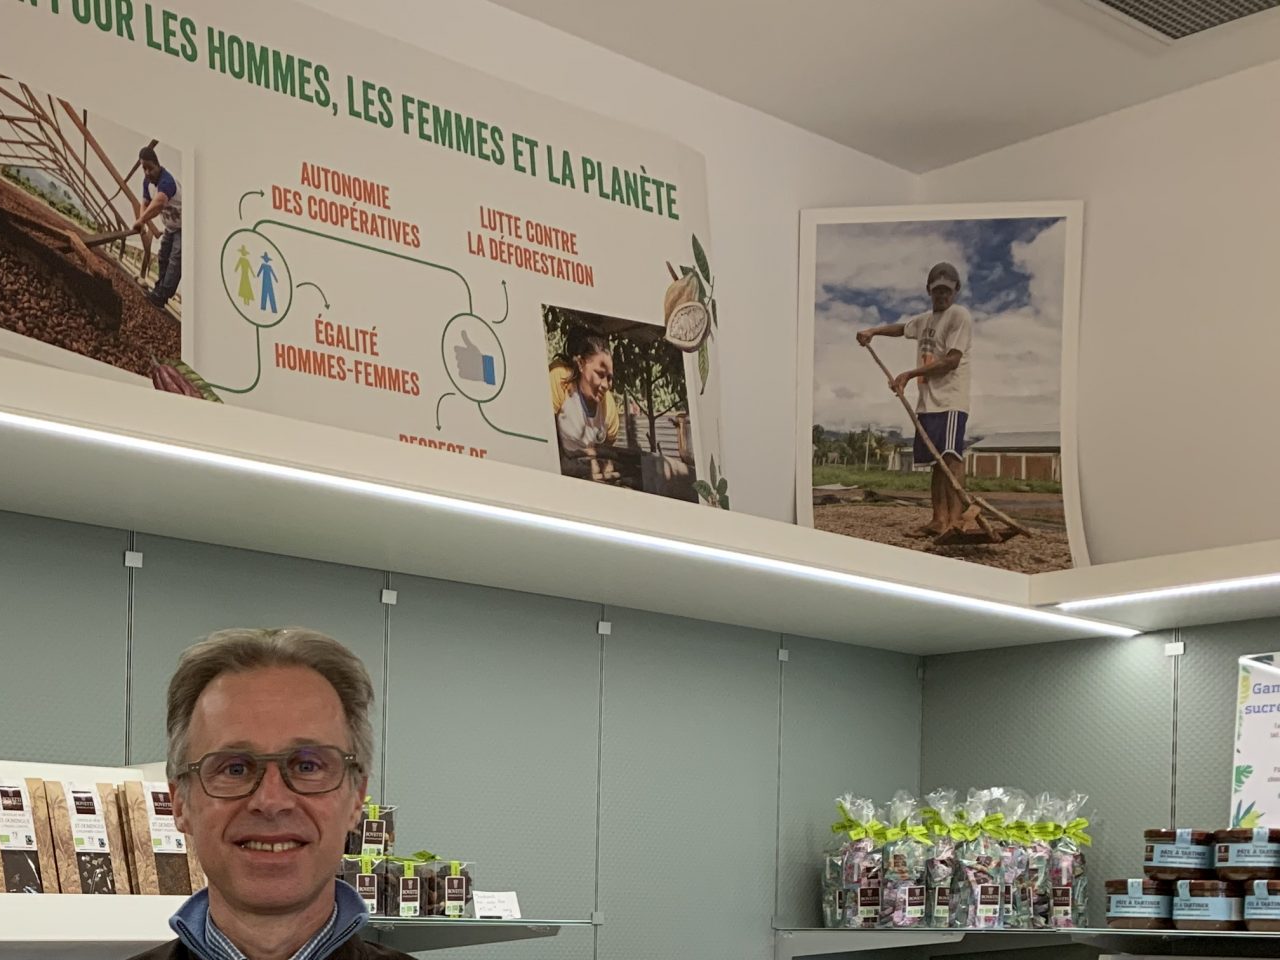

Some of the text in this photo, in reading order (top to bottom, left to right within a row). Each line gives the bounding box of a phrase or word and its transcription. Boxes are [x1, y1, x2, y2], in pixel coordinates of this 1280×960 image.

[144, 3, 199, 63] LES
[207, 26, 338, 117] HOMMES,
[346, 74, 394, 129] LES
[401, 93, 506, 167] FEMMES
[511, 132, 539, 177] ET
[546, 144, 576, 190] LA
[581, 155, 680, 221] PLANÈTE
[300, 161, 392, 211] AUTONOMIE
[271, 184, 421, 249] DES COOPÉRATIVES
[480, 205, 579, 256] LUTTE CONTRE
[467, 230, 595, 288] LA DÉFORESTATION
[314, 313, 380, 357] ÉGALITÉ
[274, 342, 421, 397] HOMMES-FEMMES
